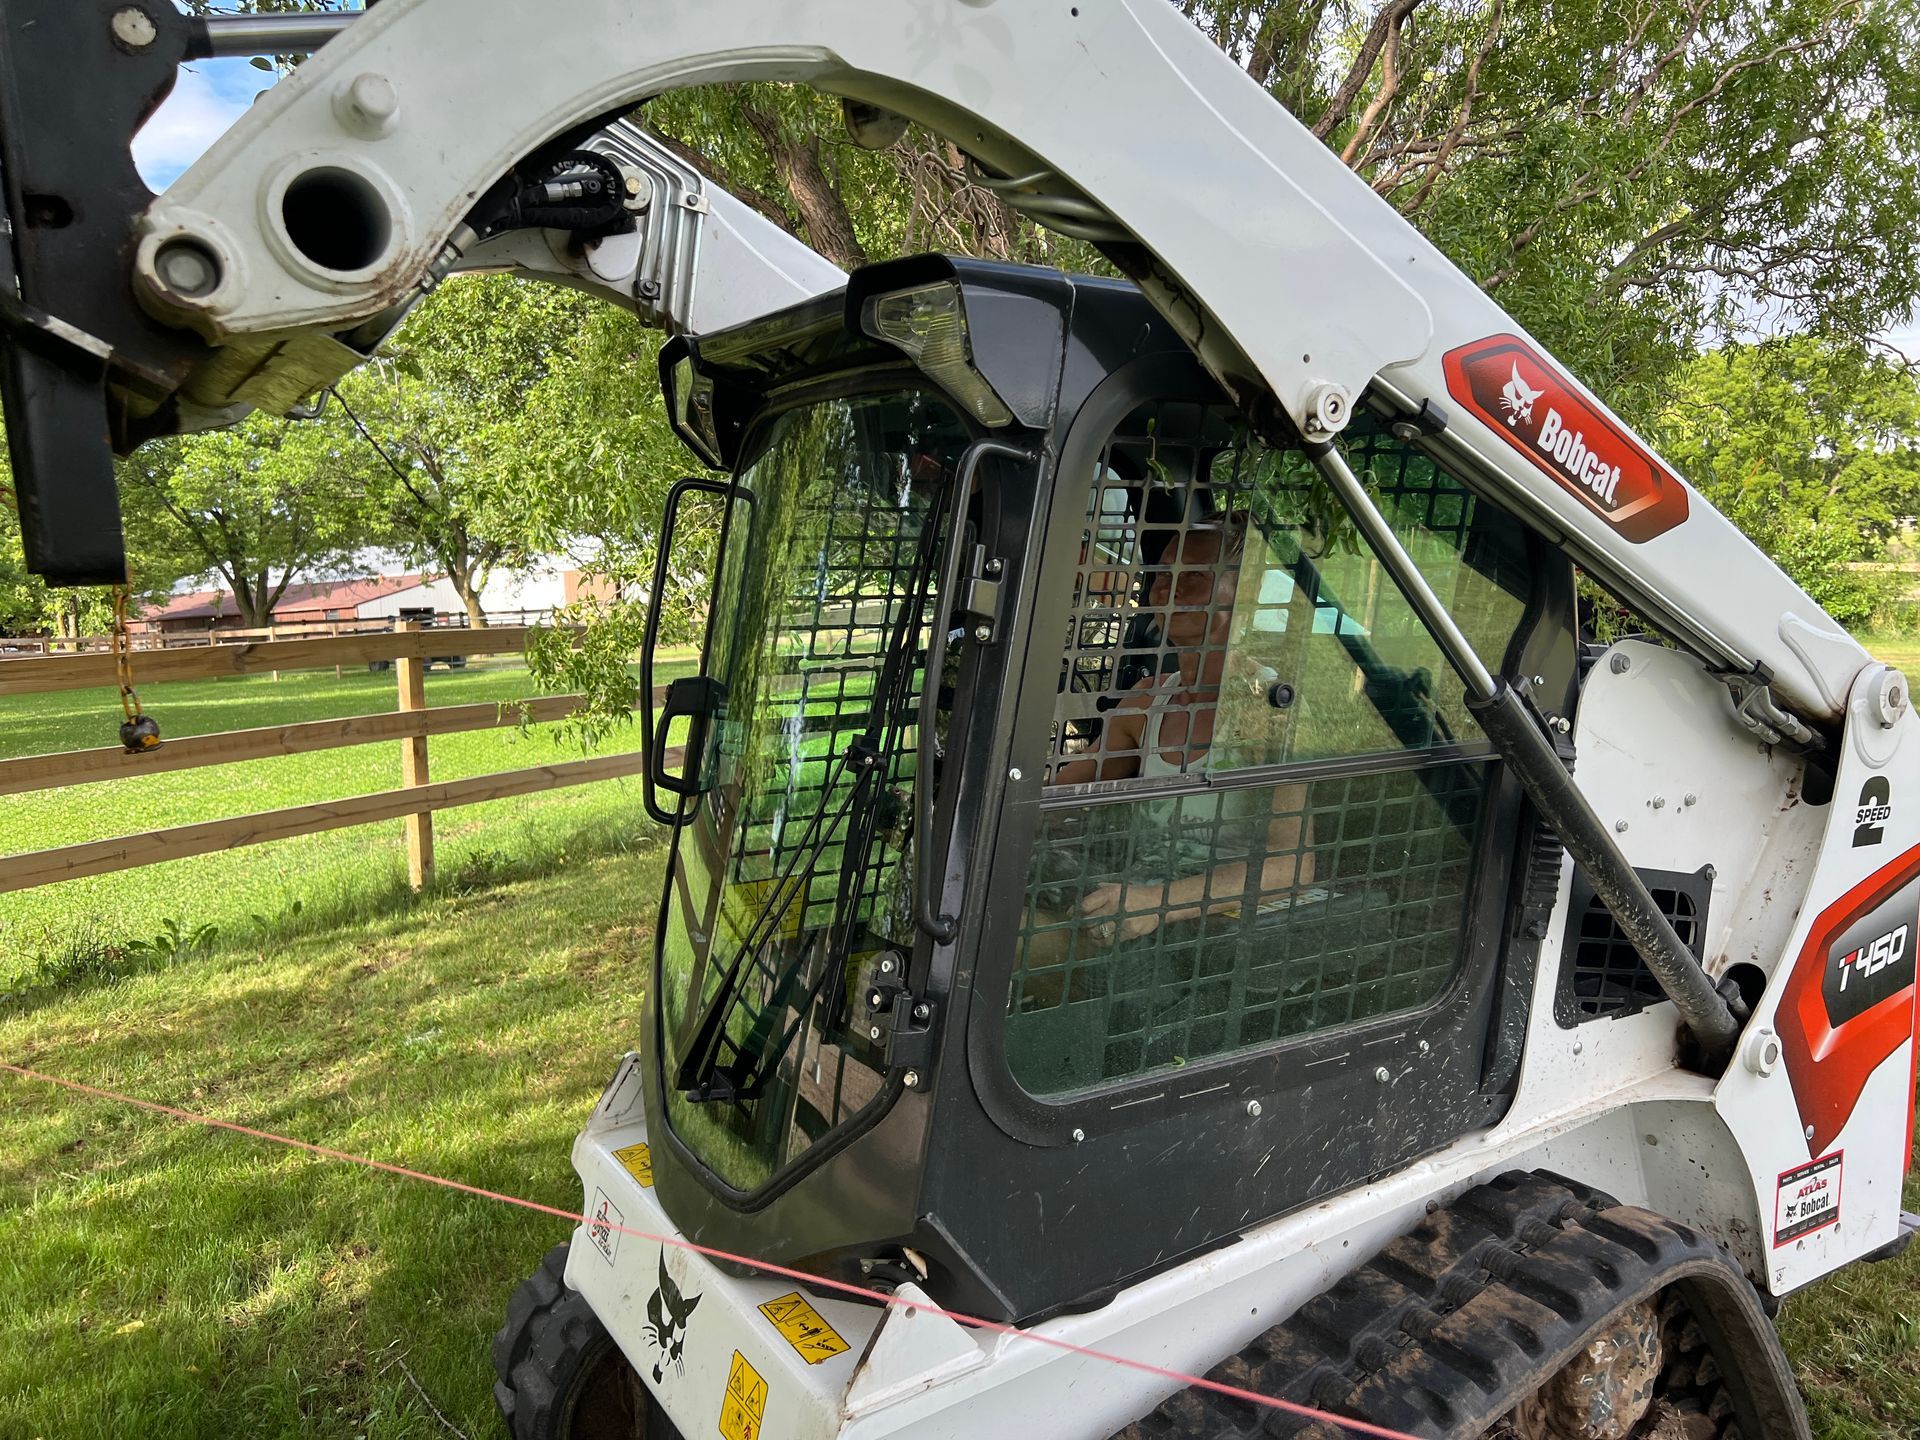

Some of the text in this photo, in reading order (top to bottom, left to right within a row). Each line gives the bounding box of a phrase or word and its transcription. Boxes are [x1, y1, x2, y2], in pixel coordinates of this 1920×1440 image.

[1537, 407, 1621, 505] Bobcat
[1852, 775, 1890, 848] 2
[1855, 806, 1891, 824] SPEED
[1838, 924, 1908, 993] T450
[1797, 1179, 1828, 1199] ATLAS
[1801, 1192, 1829, 1218] Bobcat
